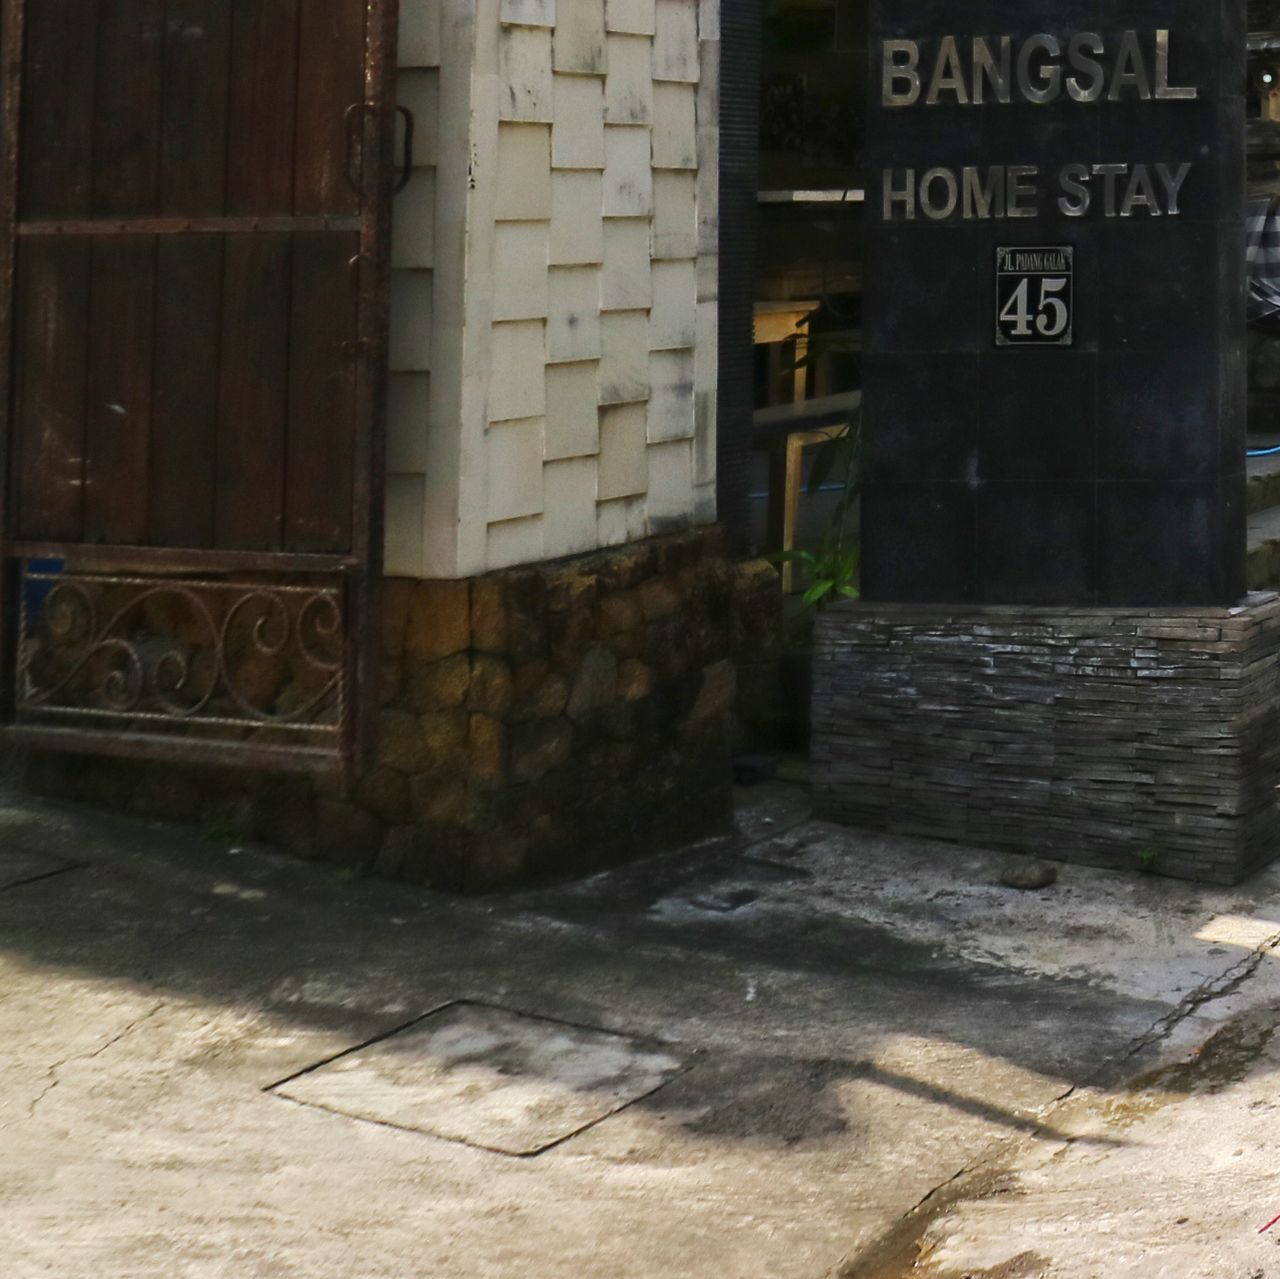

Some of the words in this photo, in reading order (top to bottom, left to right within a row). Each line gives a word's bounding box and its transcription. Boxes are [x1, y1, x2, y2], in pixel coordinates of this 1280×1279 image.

[882, 29, 1198, 107] BANGSAL
[882, 165, 1038, 221] HOME
[1057, 162, 1191, 218] STAY
[1000, 277, 1068, 336] 45
